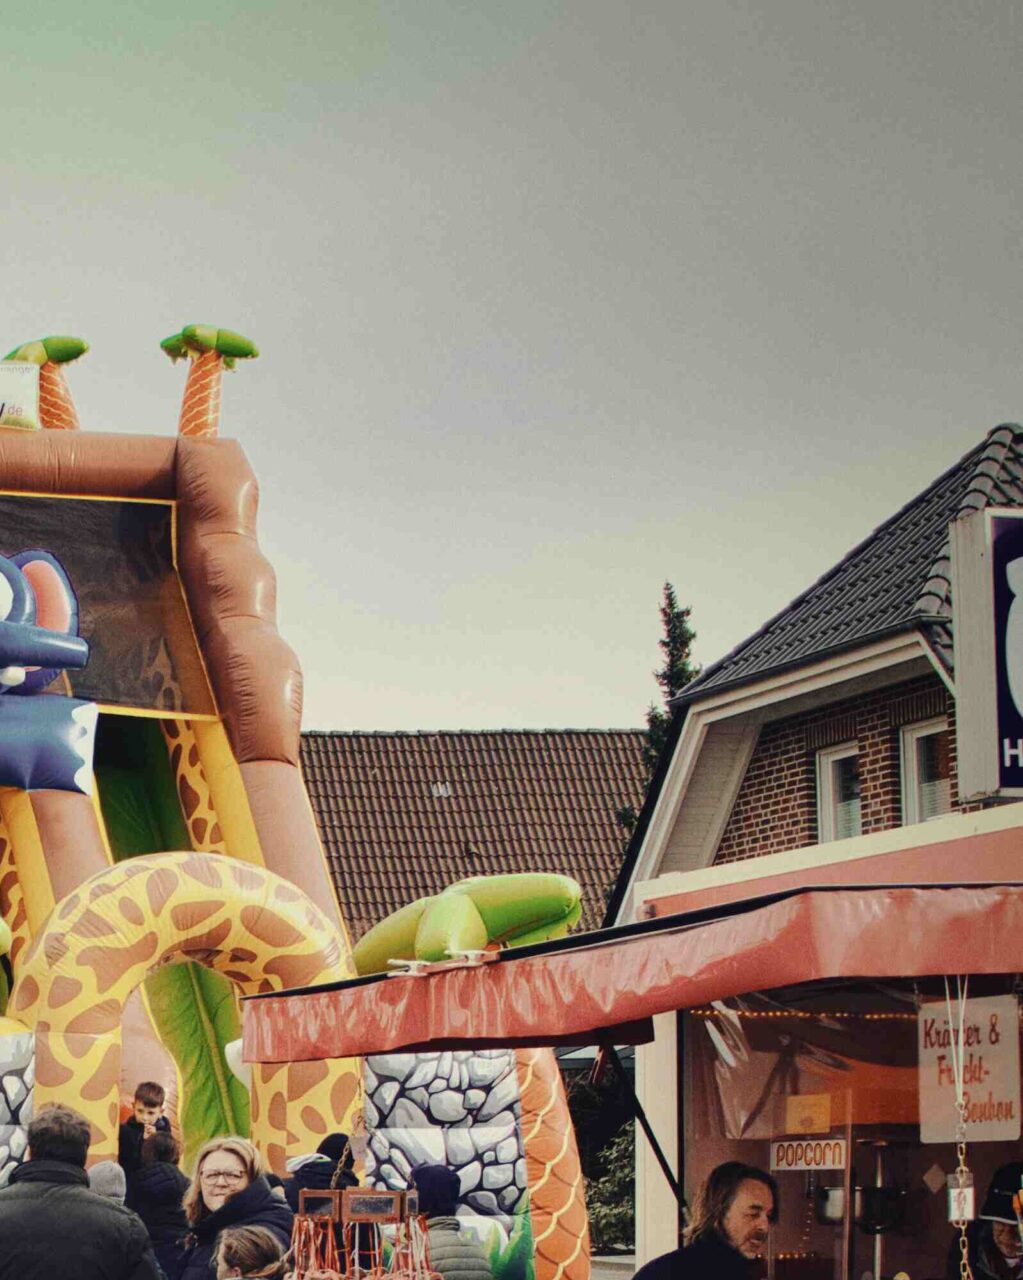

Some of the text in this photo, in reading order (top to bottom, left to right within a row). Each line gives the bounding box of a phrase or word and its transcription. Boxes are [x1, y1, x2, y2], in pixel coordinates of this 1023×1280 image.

[923, 1013, 1001, 1049] Kräer &
[937, 1053, 990, 1086] Frcht-
